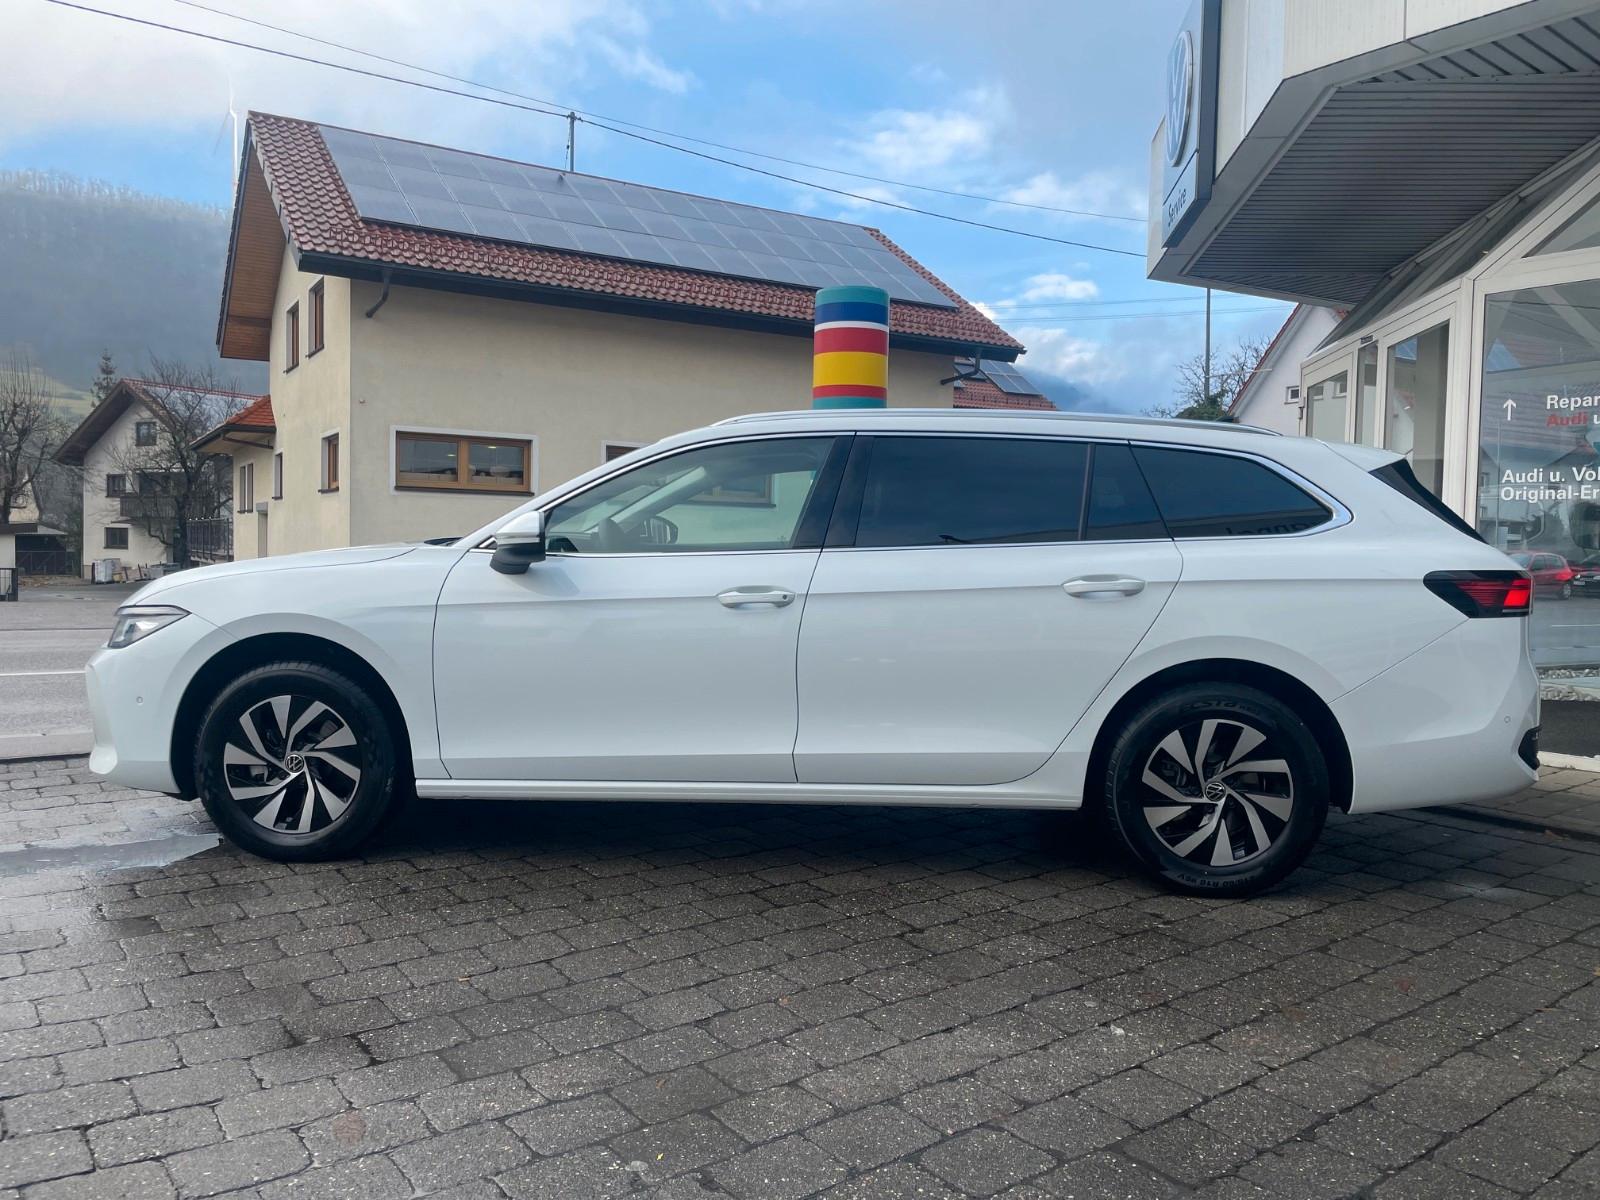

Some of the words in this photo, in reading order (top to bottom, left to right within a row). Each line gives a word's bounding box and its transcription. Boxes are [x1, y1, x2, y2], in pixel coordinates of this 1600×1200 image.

[1166, 188, 1187, 227] Service
[1546, 395, 1600, 411] Repar
[1547, 411, 1588, 426] Audi
[1502, 468, 1543, 483] Audi
[1549, 471, 1565, 482] u.
[1501, 485, 1600, 503] Original-Er
